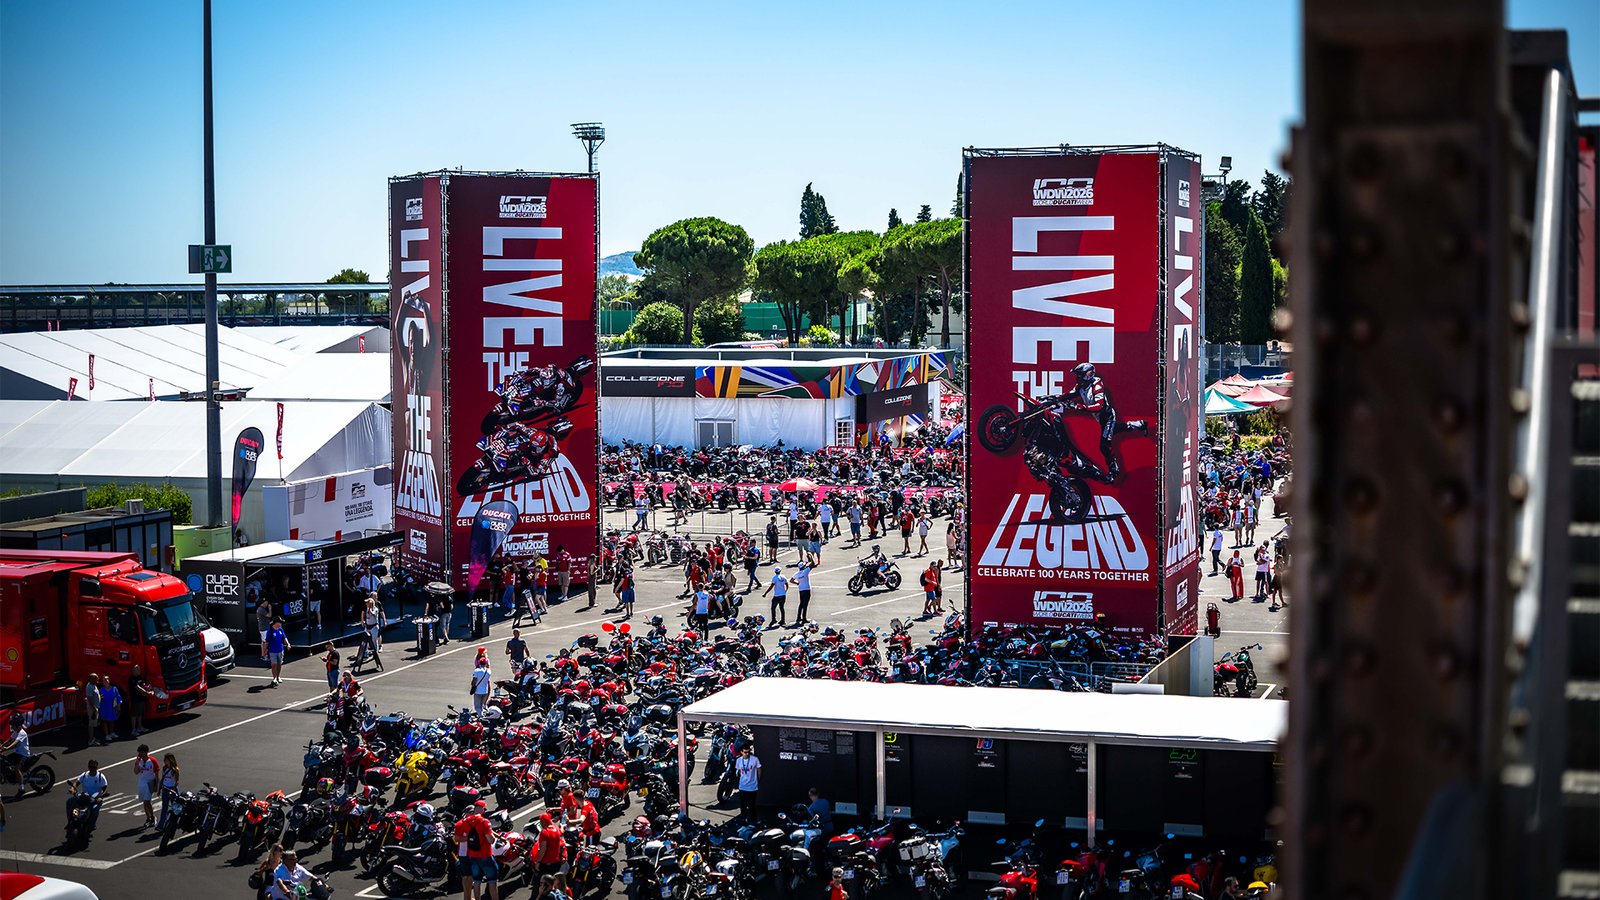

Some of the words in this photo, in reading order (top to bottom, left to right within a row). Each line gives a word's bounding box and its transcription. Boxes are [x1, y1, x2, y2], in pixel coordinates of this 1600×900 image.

[1033, 189, 1094, 200] WDW2026
[499, 204, 547, 213] WDW2026
[482, 226, 563, 348] LIVE
[1012, 216, 1115, 364] LIVE
[1012, 371, 1064, 413] THE
[884, 394, 913, 405] COLLEZIONE
[407, 394, 432, 453] THE
[396, 449, 442, 517] LEGEND
[482, 509, 512, 520] DUCATI
[520, 514, 547, 523] YEARS
[548, 513, 591, 522] TOGETHER
[978, 494, 1149, 571] LEGEND
[502, 540, 549, 552] WDW2026
[206, 574, 239, 585] QUAD
[978, 568, 1036, 579] CELEBRATE
[1038, 569, 1055, 579] 100
[1056, 570, 1091, 580] YEARS
[1093, 571, 1150, 582] TOGETHER
[206, 584, 240, 595] LOCK
[1033, 601, 1094, 612] WDW2026
[21, 701, 65, 729] UCATI
